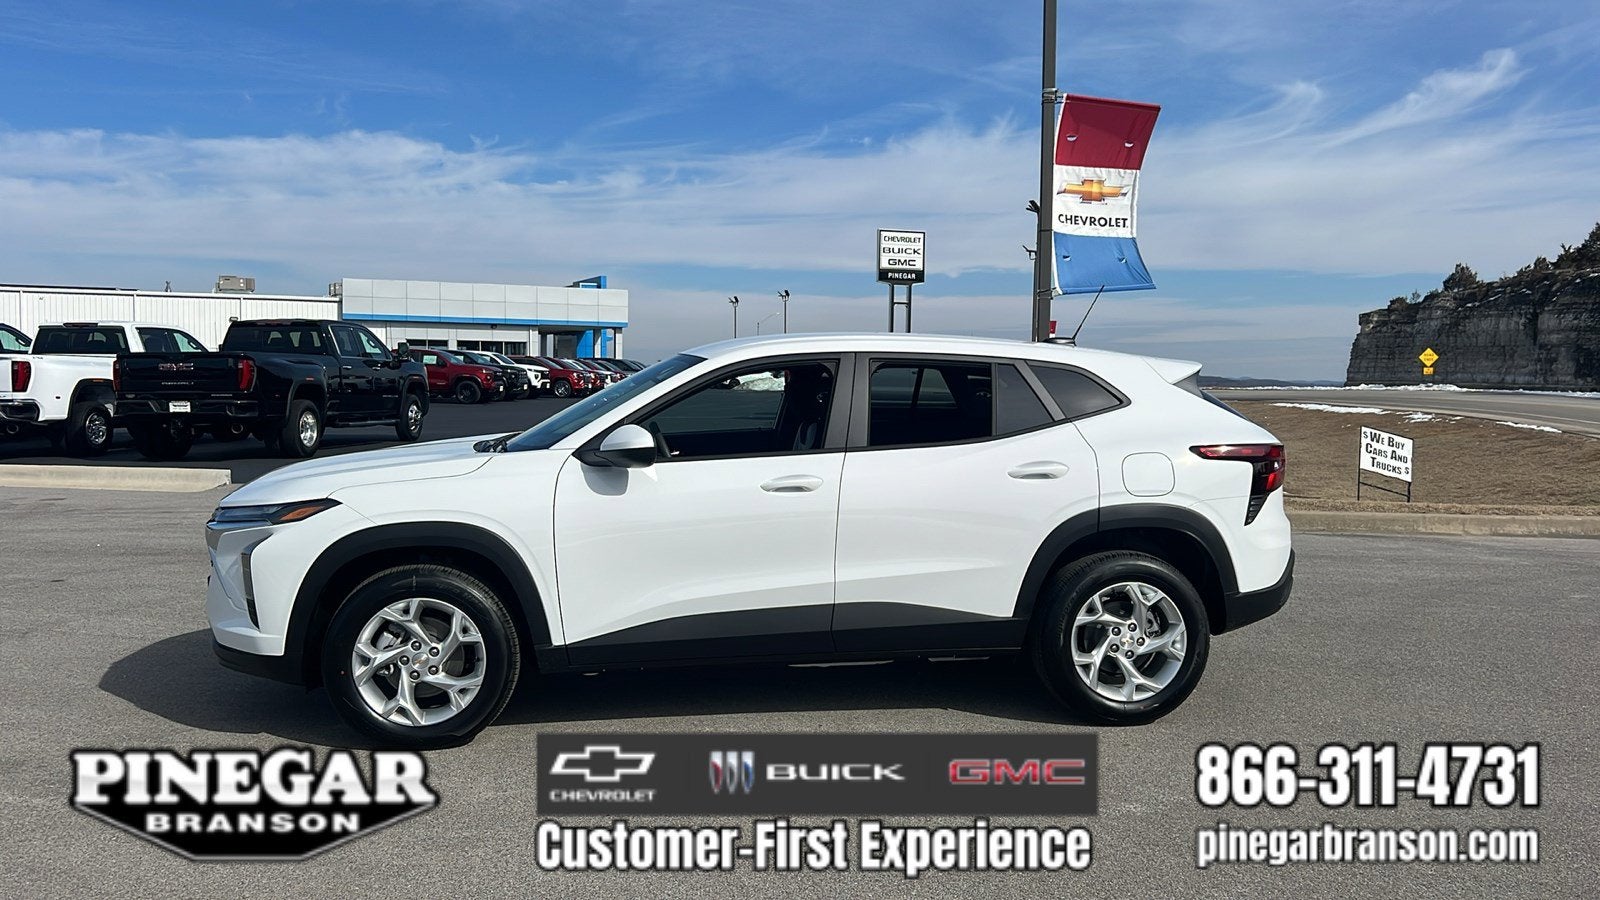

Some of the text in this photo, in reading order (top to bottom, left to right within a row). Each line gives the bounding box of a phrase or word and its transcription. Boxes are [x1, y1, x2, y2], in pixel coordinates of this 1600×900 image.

[1058, 213, 1128, 228] CHEVROLET
[884, 235, 921, 243] CHEVROLET
[883, 247, 921, 255] BUICK
